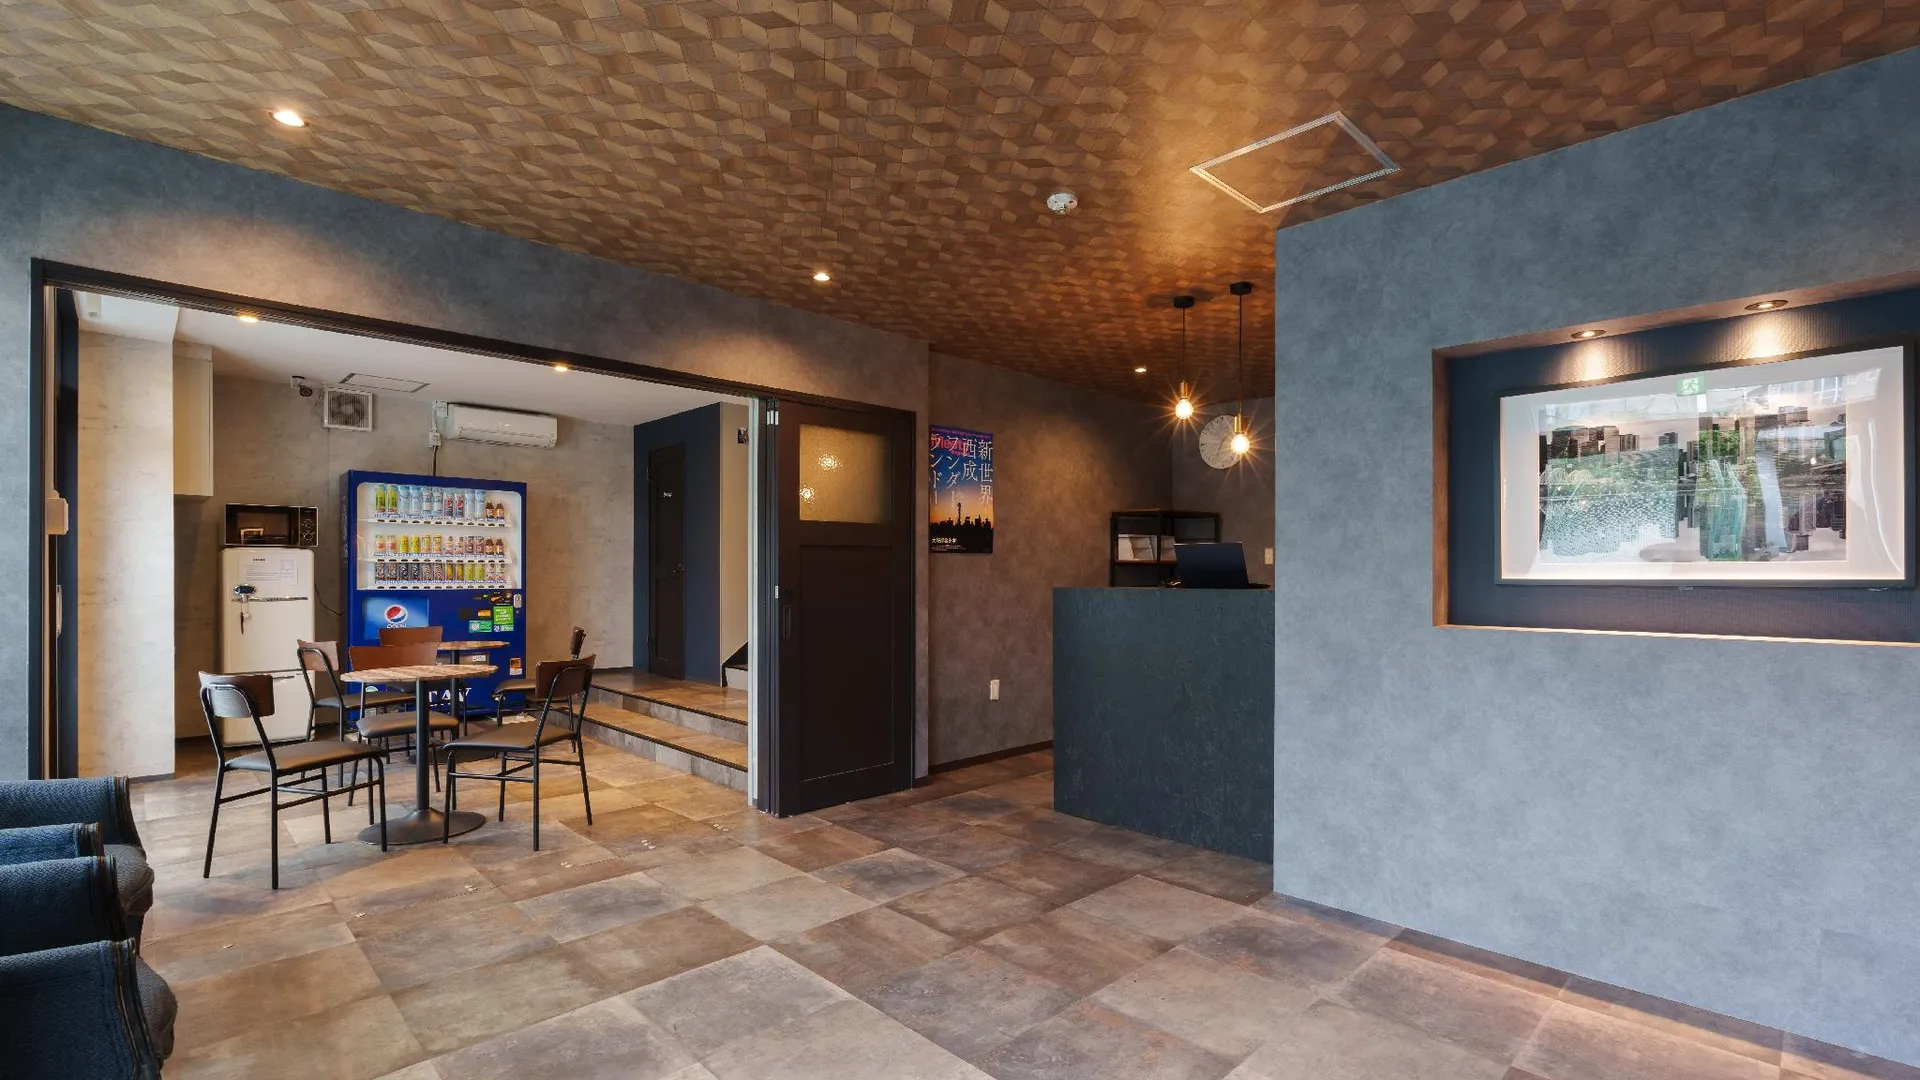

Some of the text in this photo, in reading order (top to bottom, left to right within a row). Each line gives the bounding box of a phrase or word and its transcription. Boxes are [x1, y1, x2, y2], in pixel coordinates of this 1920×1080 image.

[961, 438, 977, 481] 西成
[978, 440, 993, 505] 新世界
